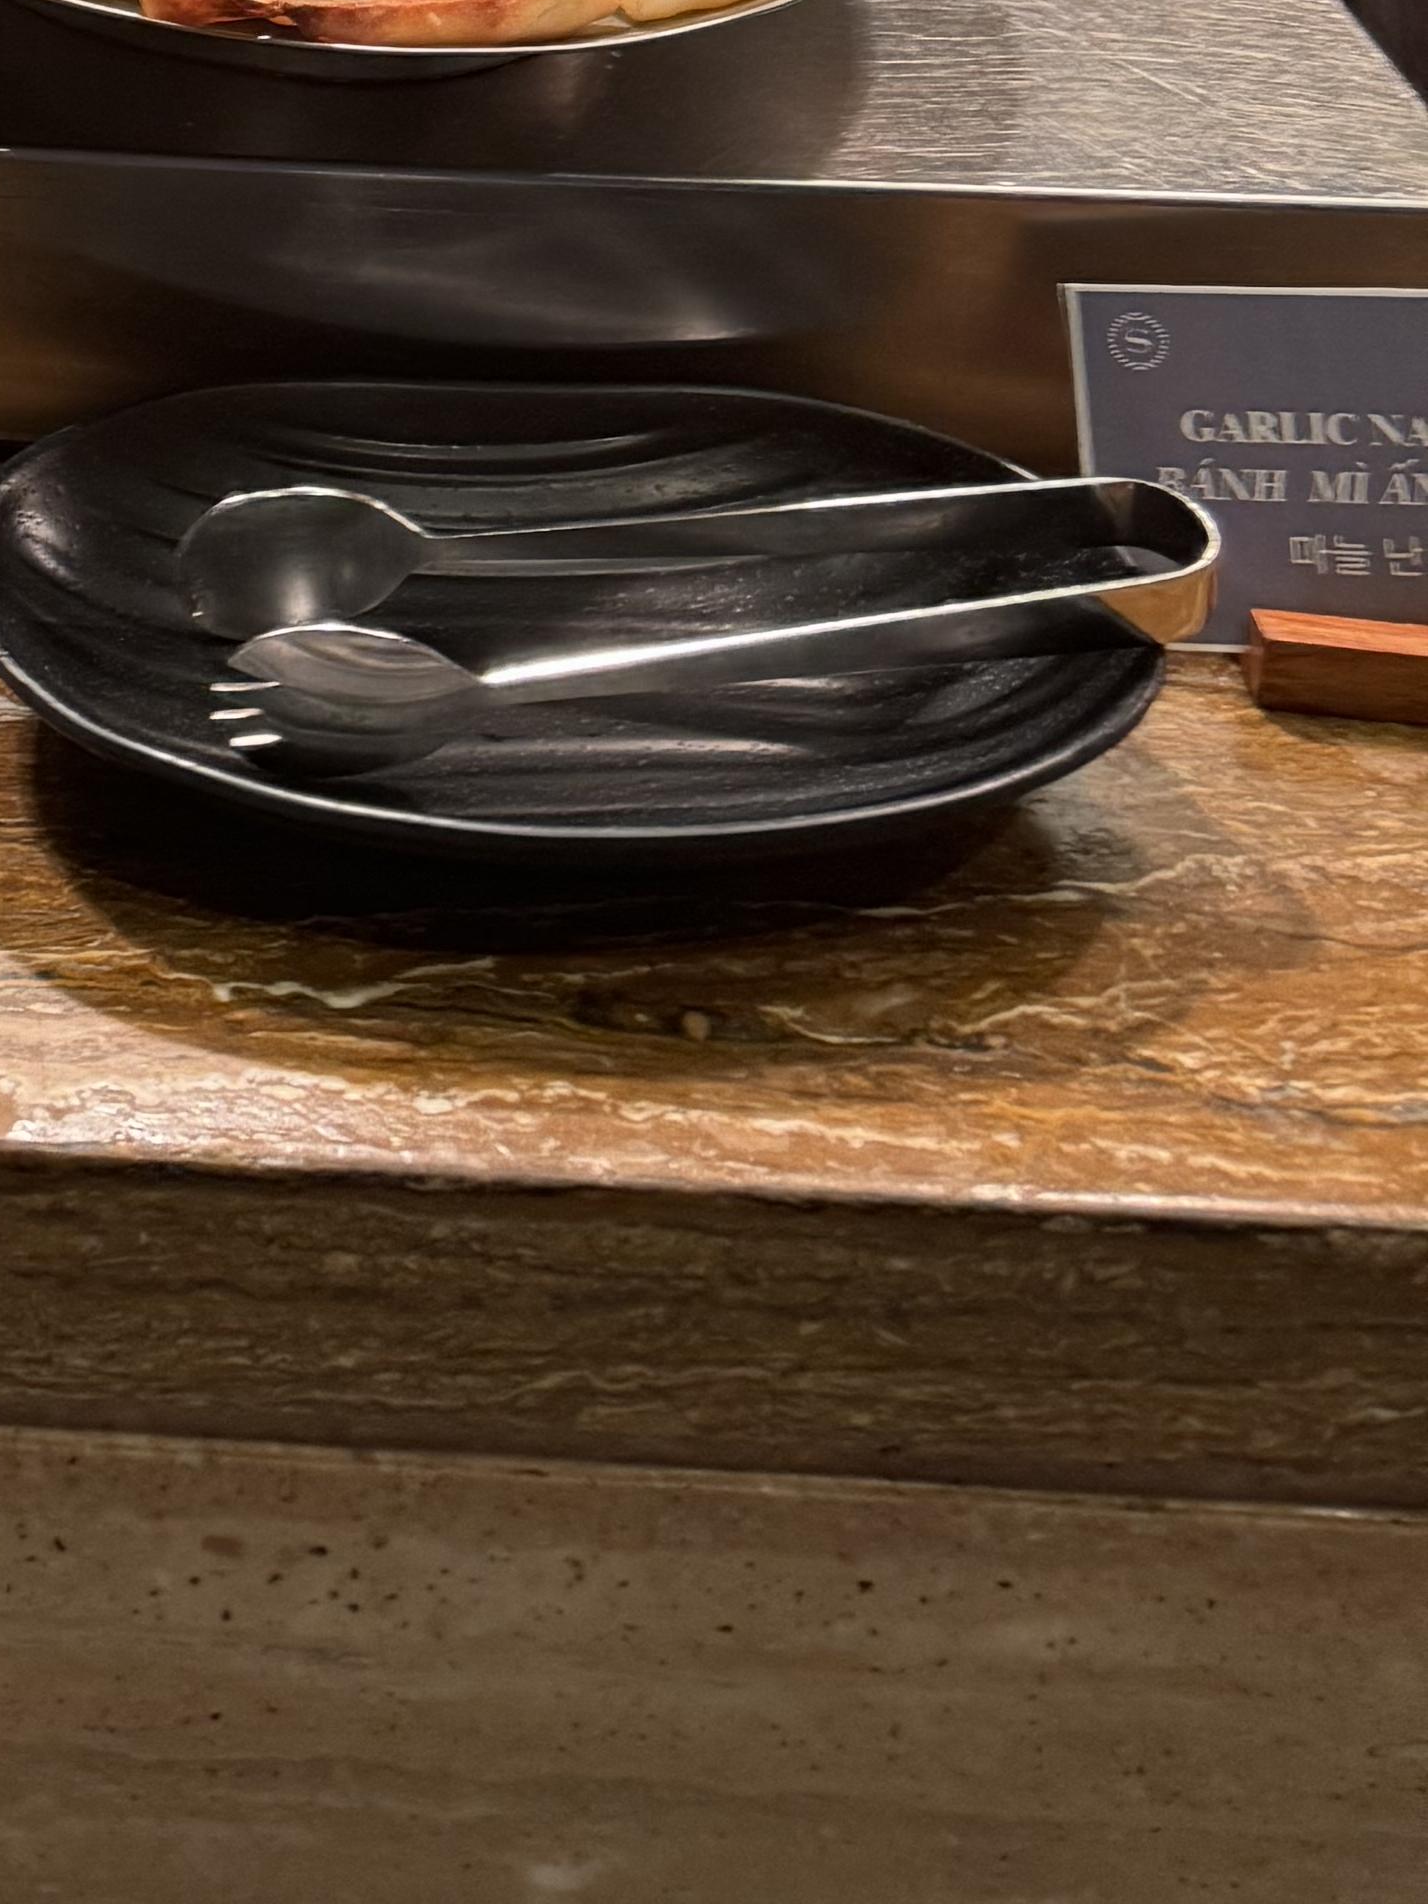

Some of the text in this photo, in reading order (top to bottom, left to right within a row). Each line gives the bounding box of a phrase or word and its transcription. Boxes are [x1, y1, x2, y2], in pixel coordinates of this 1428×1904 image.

[1179, 408, 1361, 446] GARLIC
[1307, 461, 1373, 505] MÌ
[1288, 533, 1425, 577] 마늘 난
